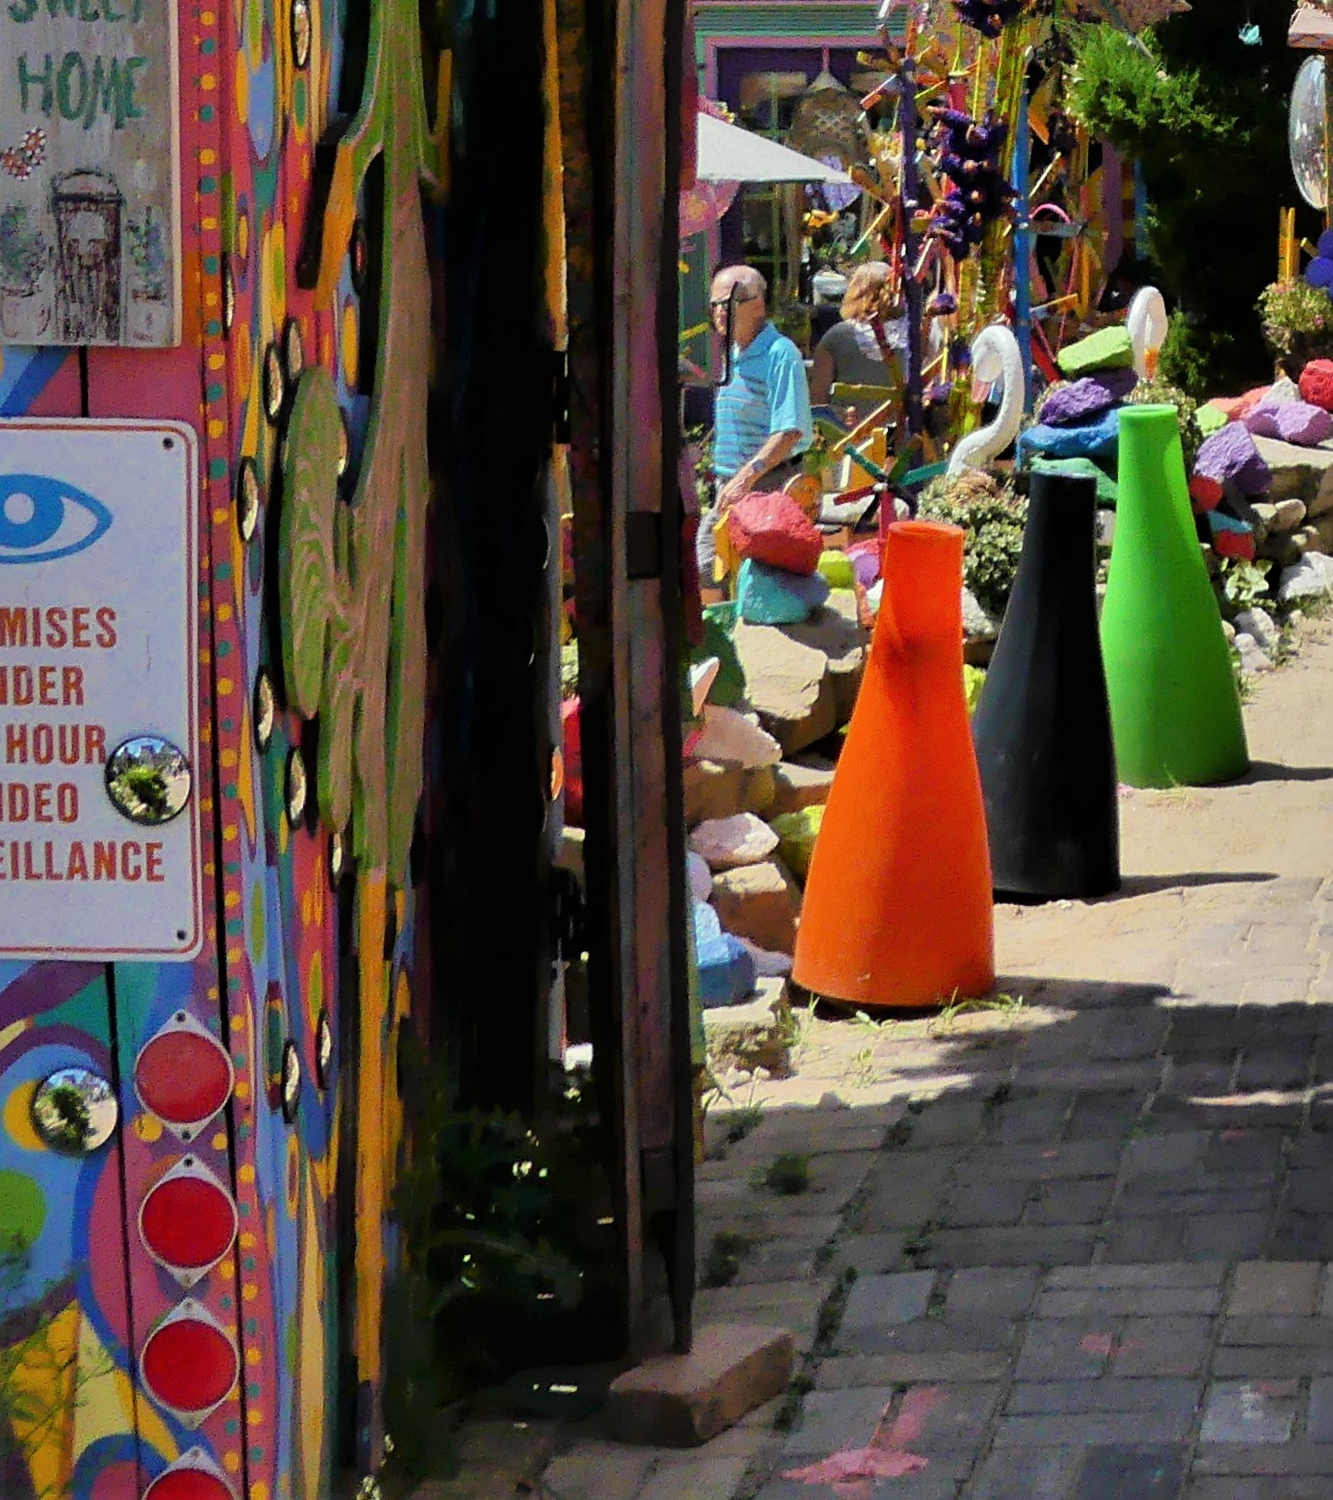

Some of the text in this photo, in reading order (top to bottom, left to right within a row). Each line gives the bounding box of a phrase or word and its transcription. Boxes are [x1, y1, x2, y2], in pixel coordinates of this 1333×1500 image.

[17, 51, 148, 130] HOME
[6, 723, 107, 765] HOUR
[0, 840, 165, 882] ILLANCE
